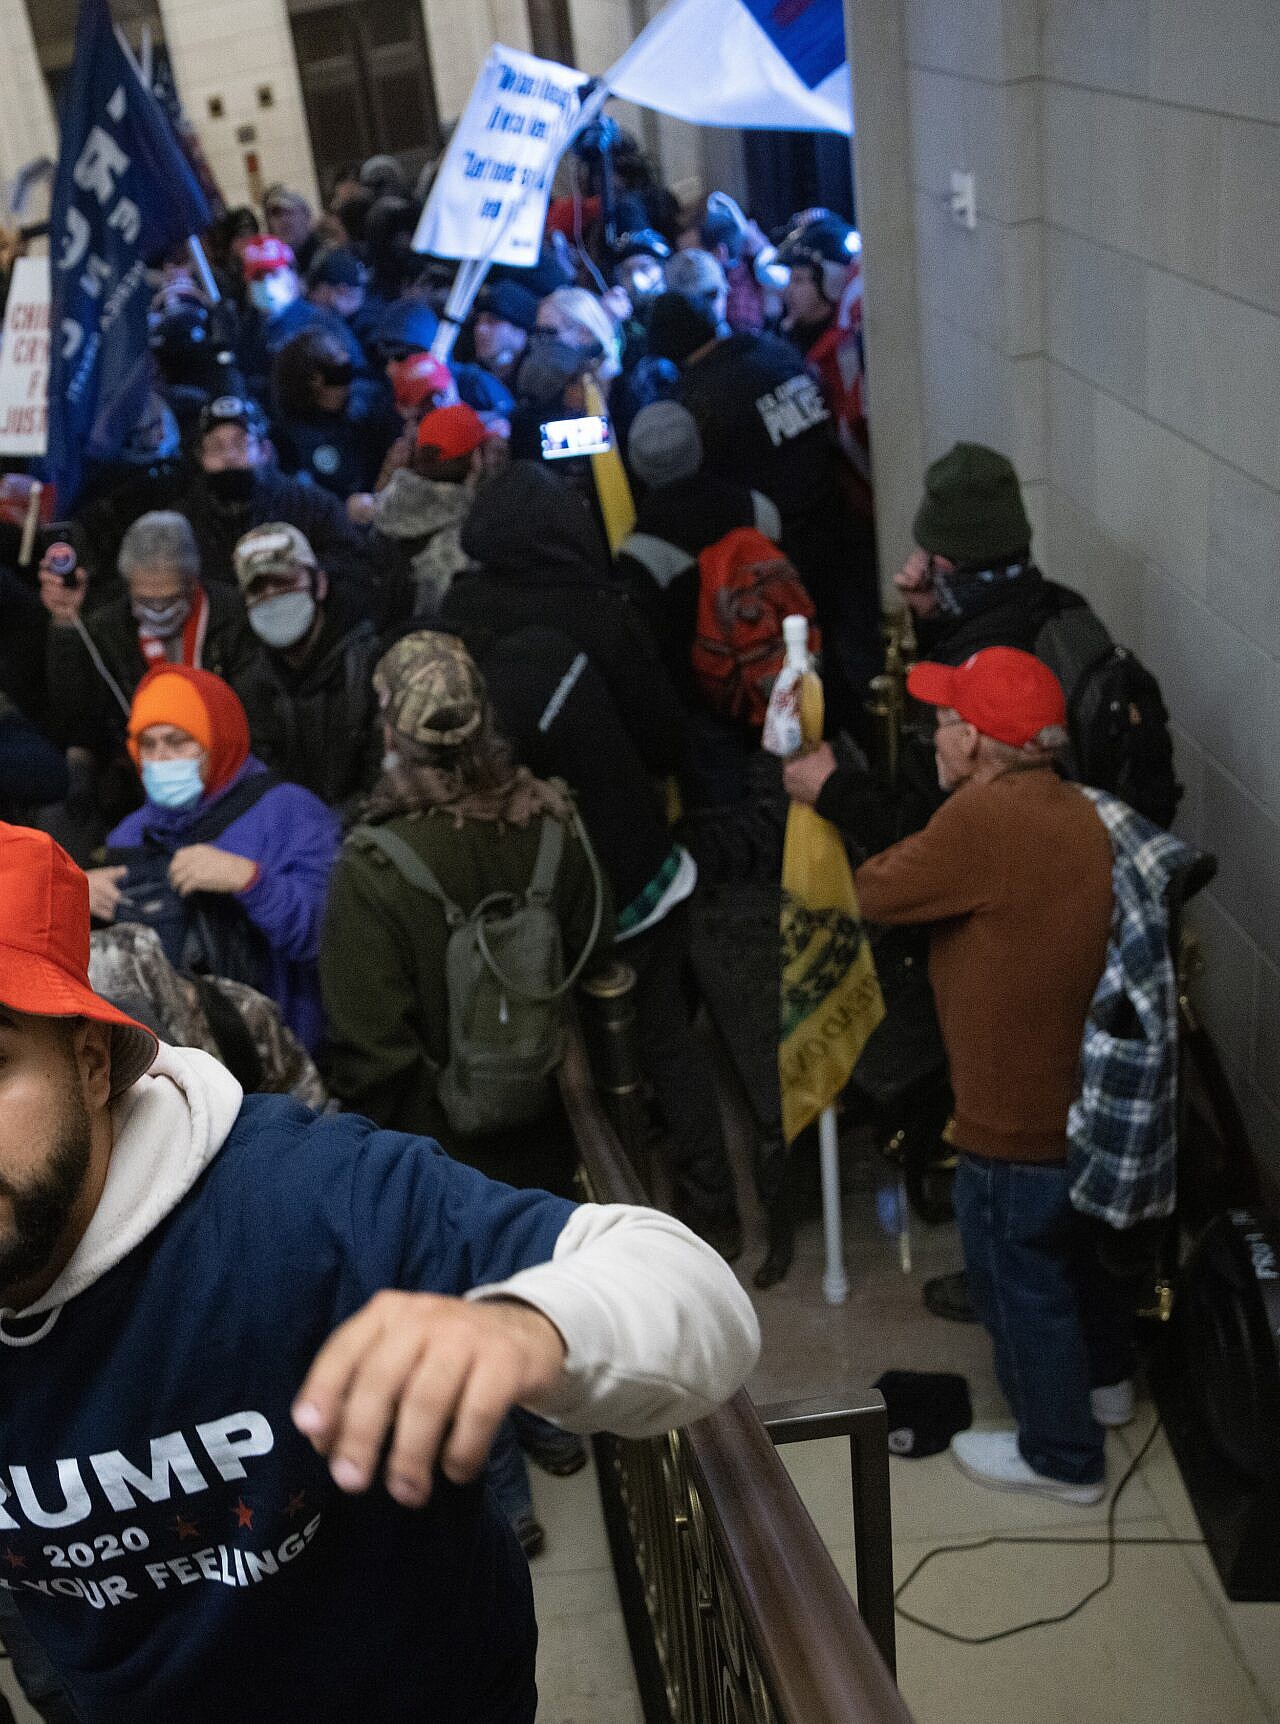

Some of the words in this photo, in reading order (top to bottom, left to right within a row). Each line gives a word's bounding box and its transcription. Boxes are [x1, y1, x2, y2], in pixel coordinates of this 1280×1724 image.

[20, 1574, 140, 1610] YOUR
[144, 1511, 322, 1591] FEELINGS
[42, 1526, 151, 1569] 2020
